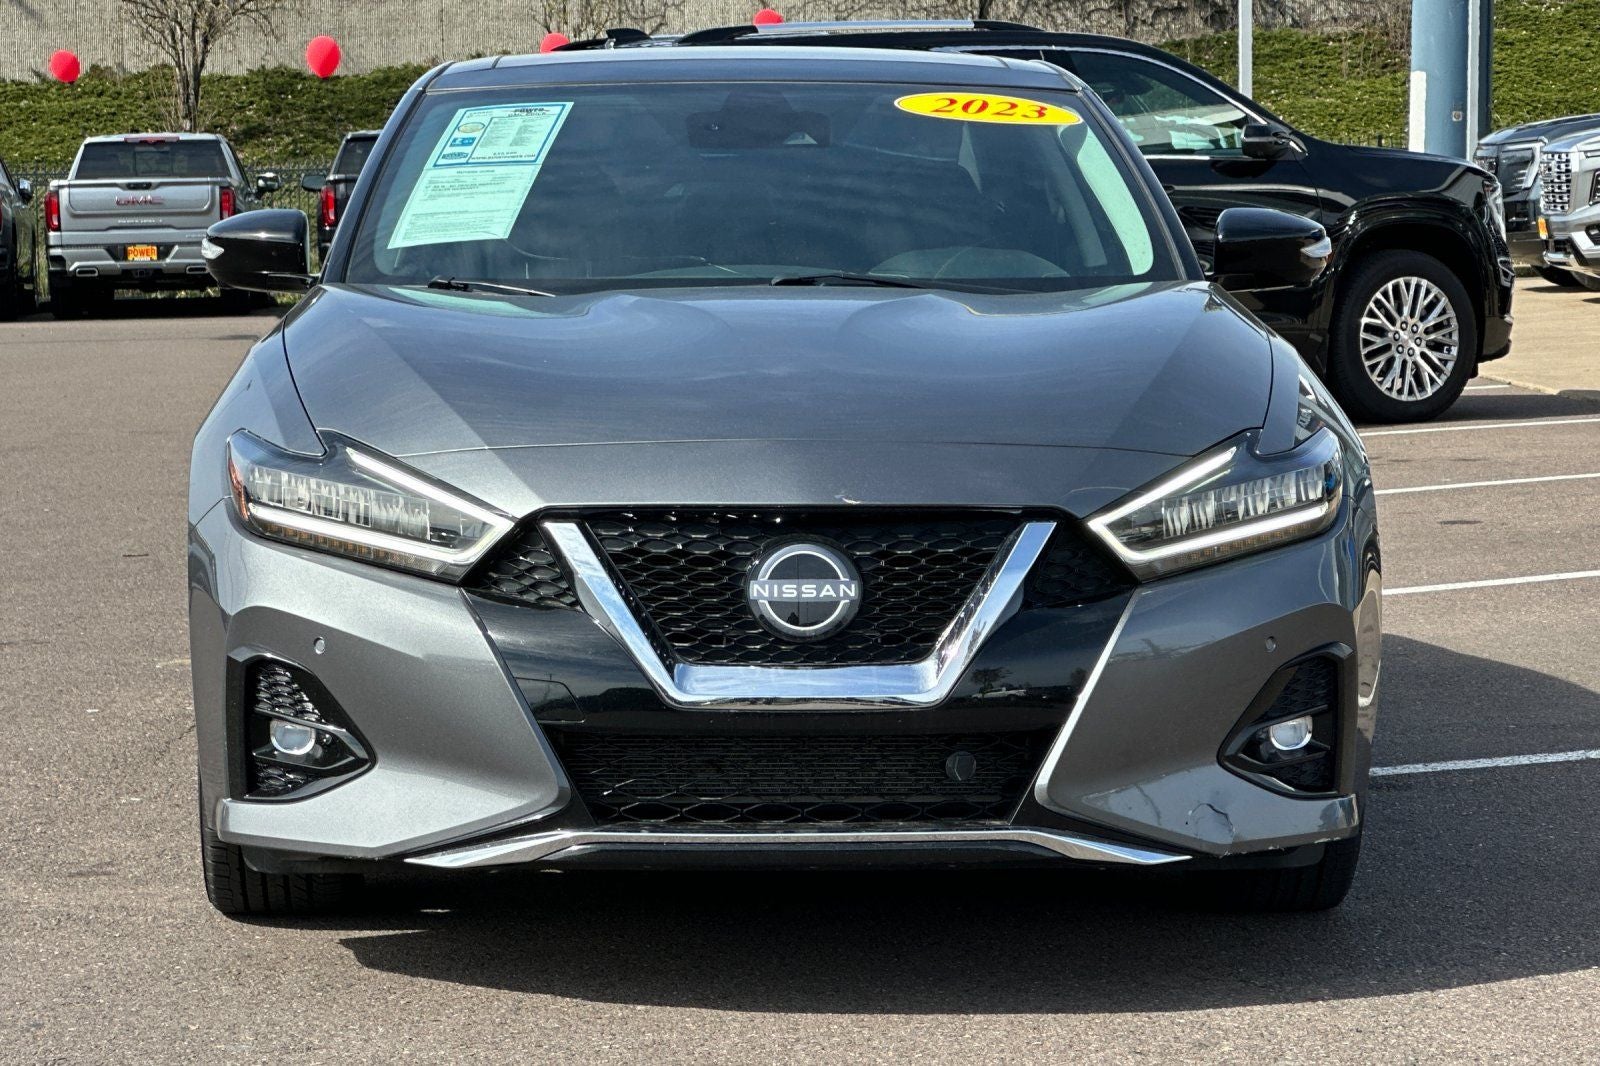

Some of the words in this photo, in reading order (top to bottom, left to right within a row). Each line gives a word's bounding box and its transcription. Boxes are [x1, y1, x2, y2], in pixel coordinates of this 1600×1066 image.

[931, 97, 1048, 118] 2023
[127, 247, 156, 257] POWER
[753, 584, 856, 598] NISSAN
